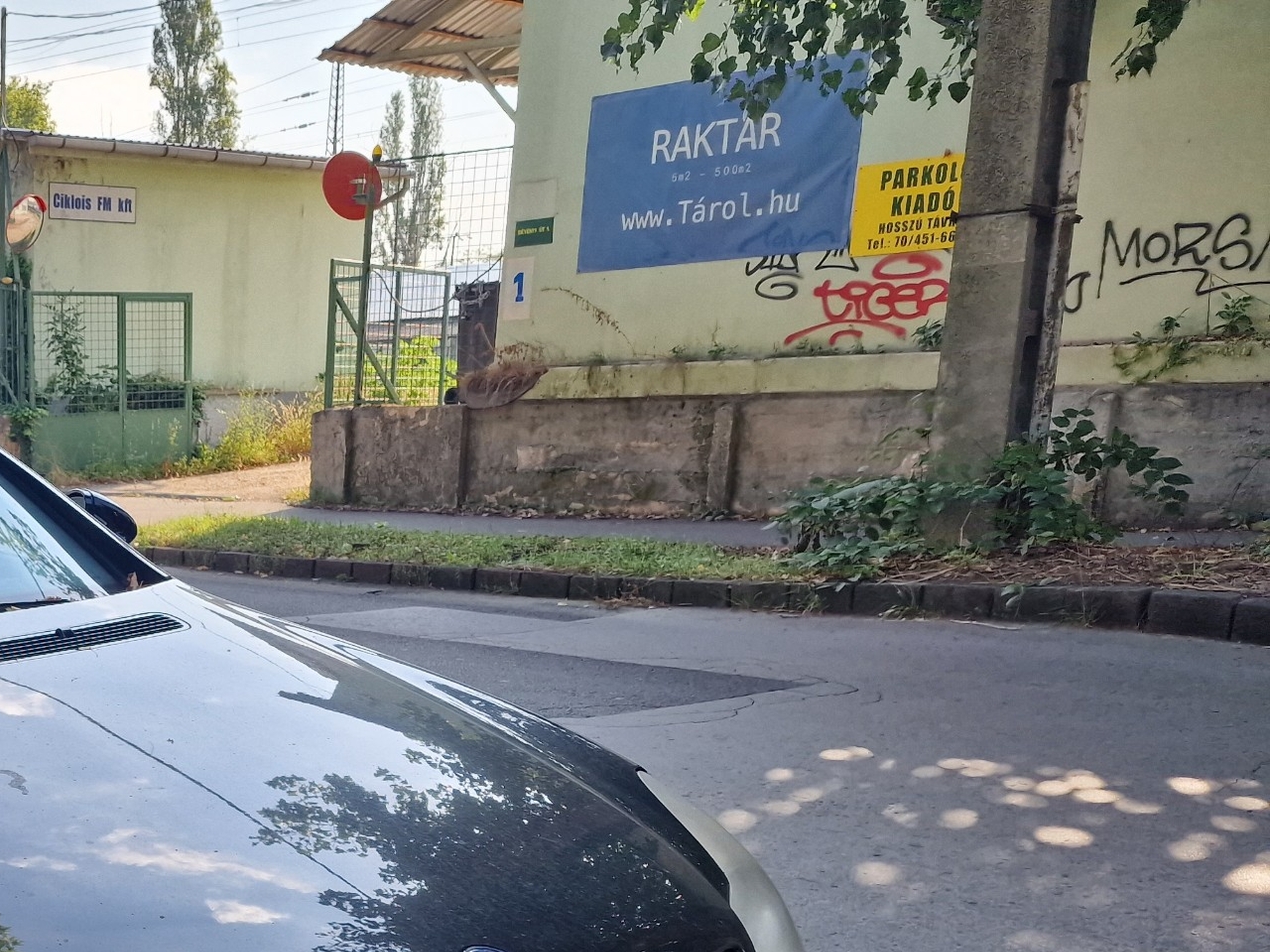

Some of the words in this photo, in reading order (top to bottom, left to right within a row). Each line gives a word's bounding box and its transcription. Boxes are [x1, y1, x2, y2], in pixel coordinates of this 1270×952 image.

[651, 110, 782, 165] RAKTÁR
[714, 163, 751, 178] 500m2
[880, 162, 959, 191] PARKOL
[53, 193, 92, 211] Ciklois
[97, 196, 112, 212] FM
[118, 198, 133, 213] kft
[621, 189, 801, 231] www.Tárol.hu
[890, 186, 955, 216] KIADÓ
[894, 231, 956, 247] 70/451-66
[513, 272, 524, 303] 1
